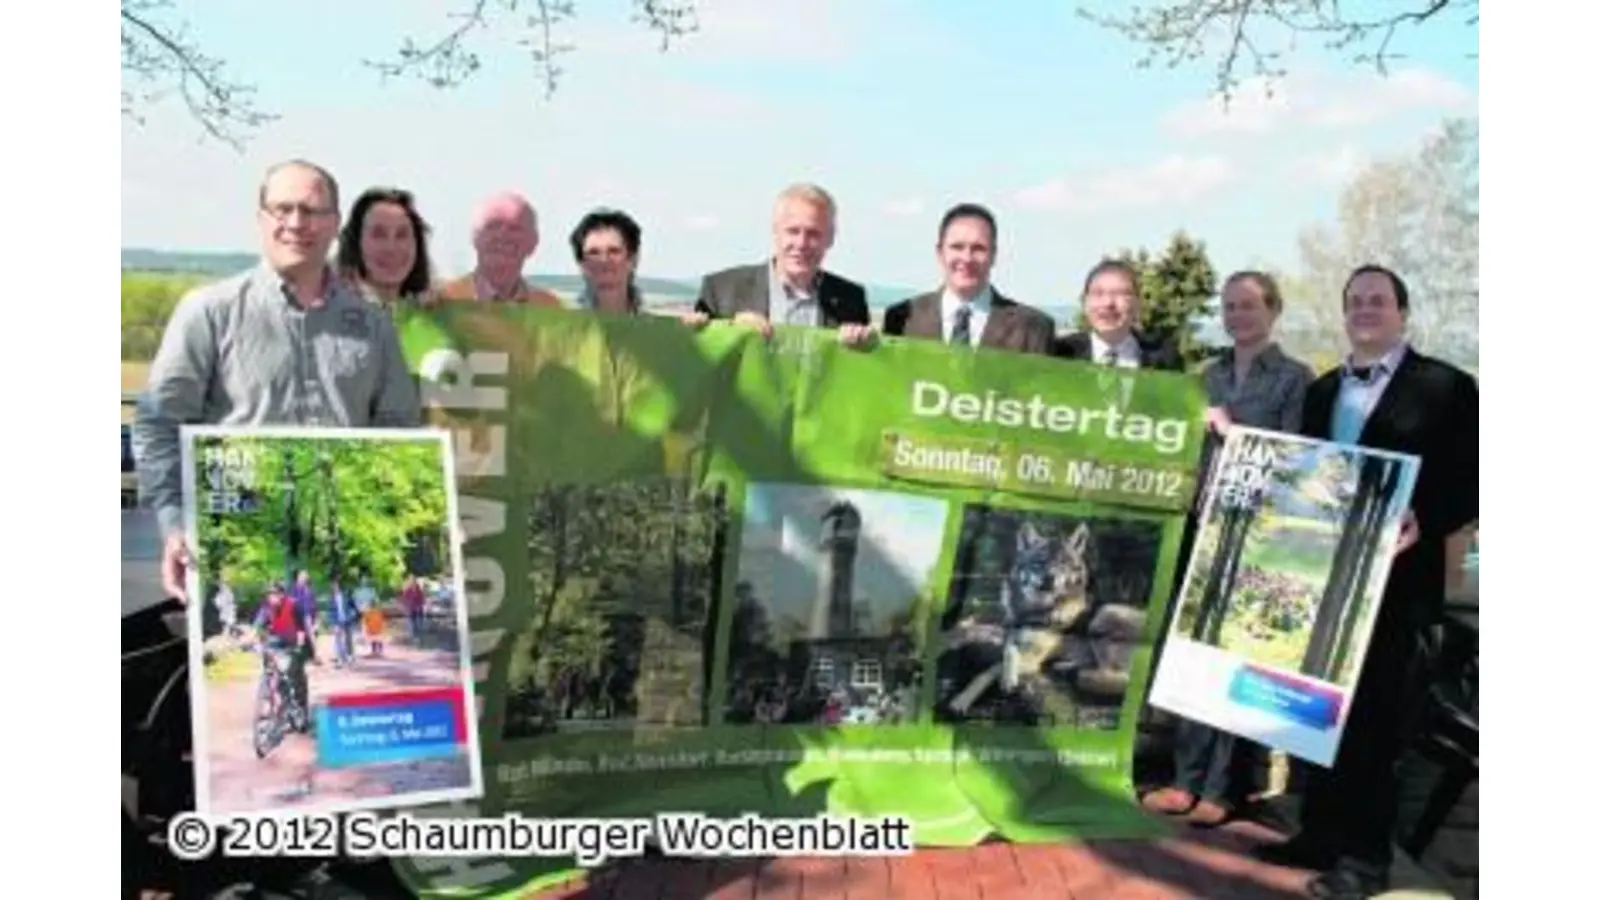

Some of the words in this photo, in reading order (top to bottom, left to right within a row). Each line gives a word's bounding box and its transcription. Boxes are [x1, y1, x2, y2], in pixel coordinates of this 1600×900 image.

[912, 380, 1188, 453] Deistertag
[894, 439, 1007, 484] Sonntag,
[1017, 454, 1054, 484] 06.
[1067, 460, 1114, 490] Mai
[1119, 466, 1182, 497] 2012
